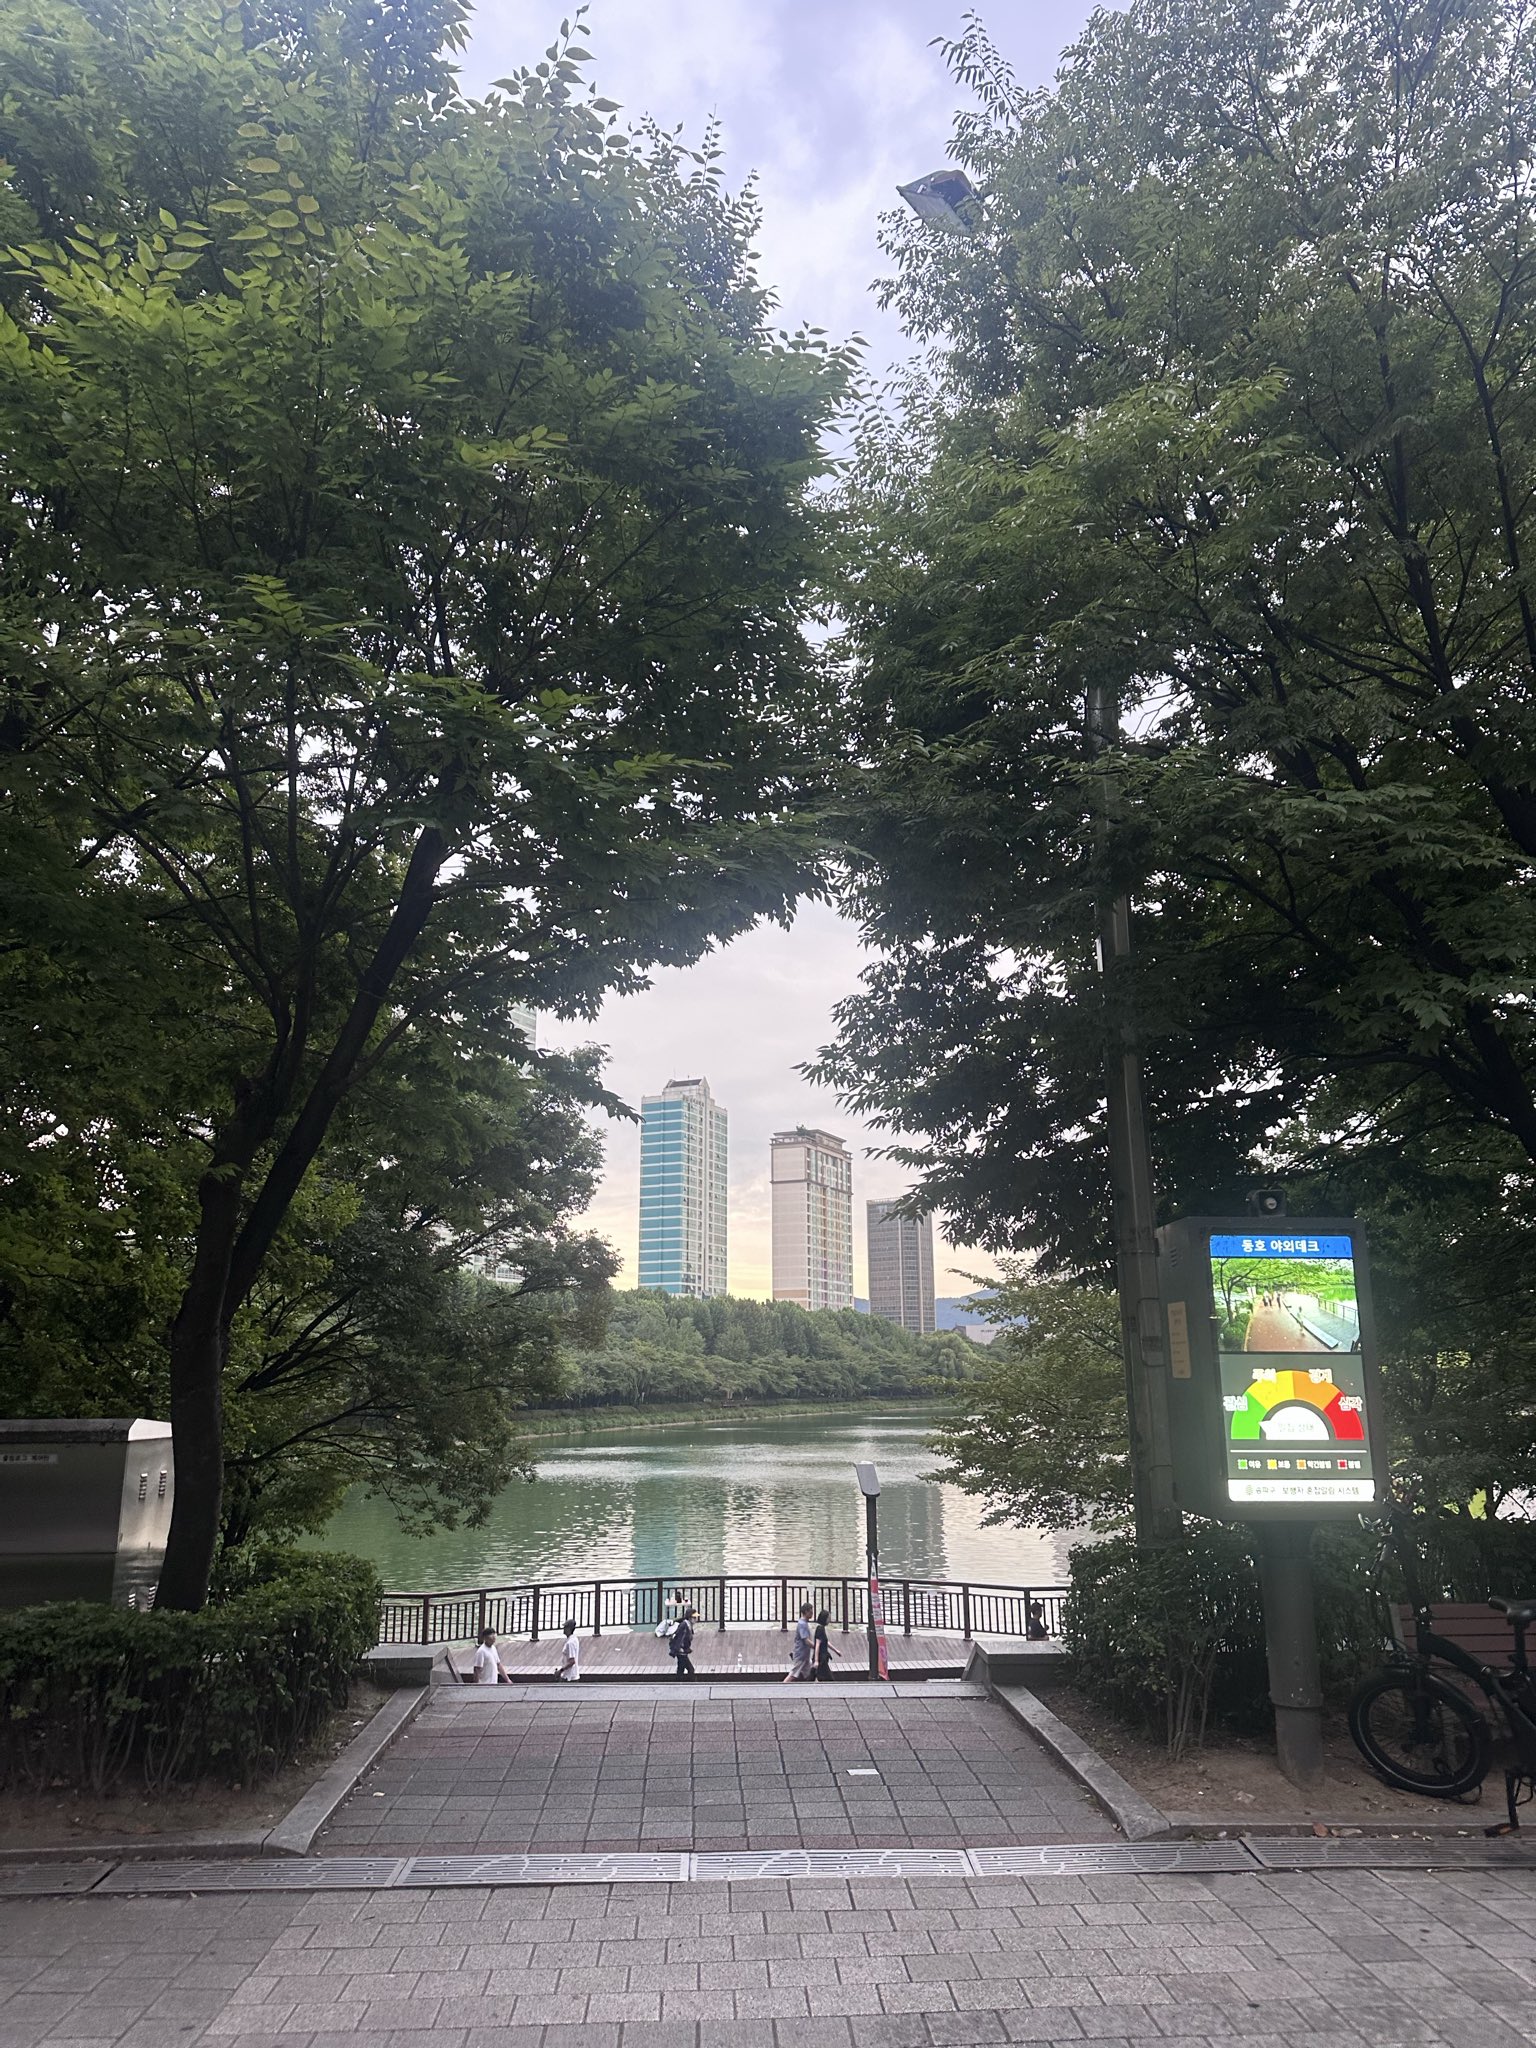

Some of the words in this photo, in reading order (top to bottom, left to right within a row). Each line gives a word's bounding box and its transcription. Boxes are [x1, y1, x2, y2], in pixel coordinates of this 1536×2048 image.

[1241, 1239, 1267, 1253] 동호
[1270, 1239, 1320, 1253] 야외데크
[1223, 1395, 1248, 1411] 관심
[1338, 1396, 1363, 1411] 심각
[1255, 1486, 1276, 1495] 송파구
[1282, 1486, 1304, 1496] 보행자
[1338, 1486, 1360, 1496] 시스템
